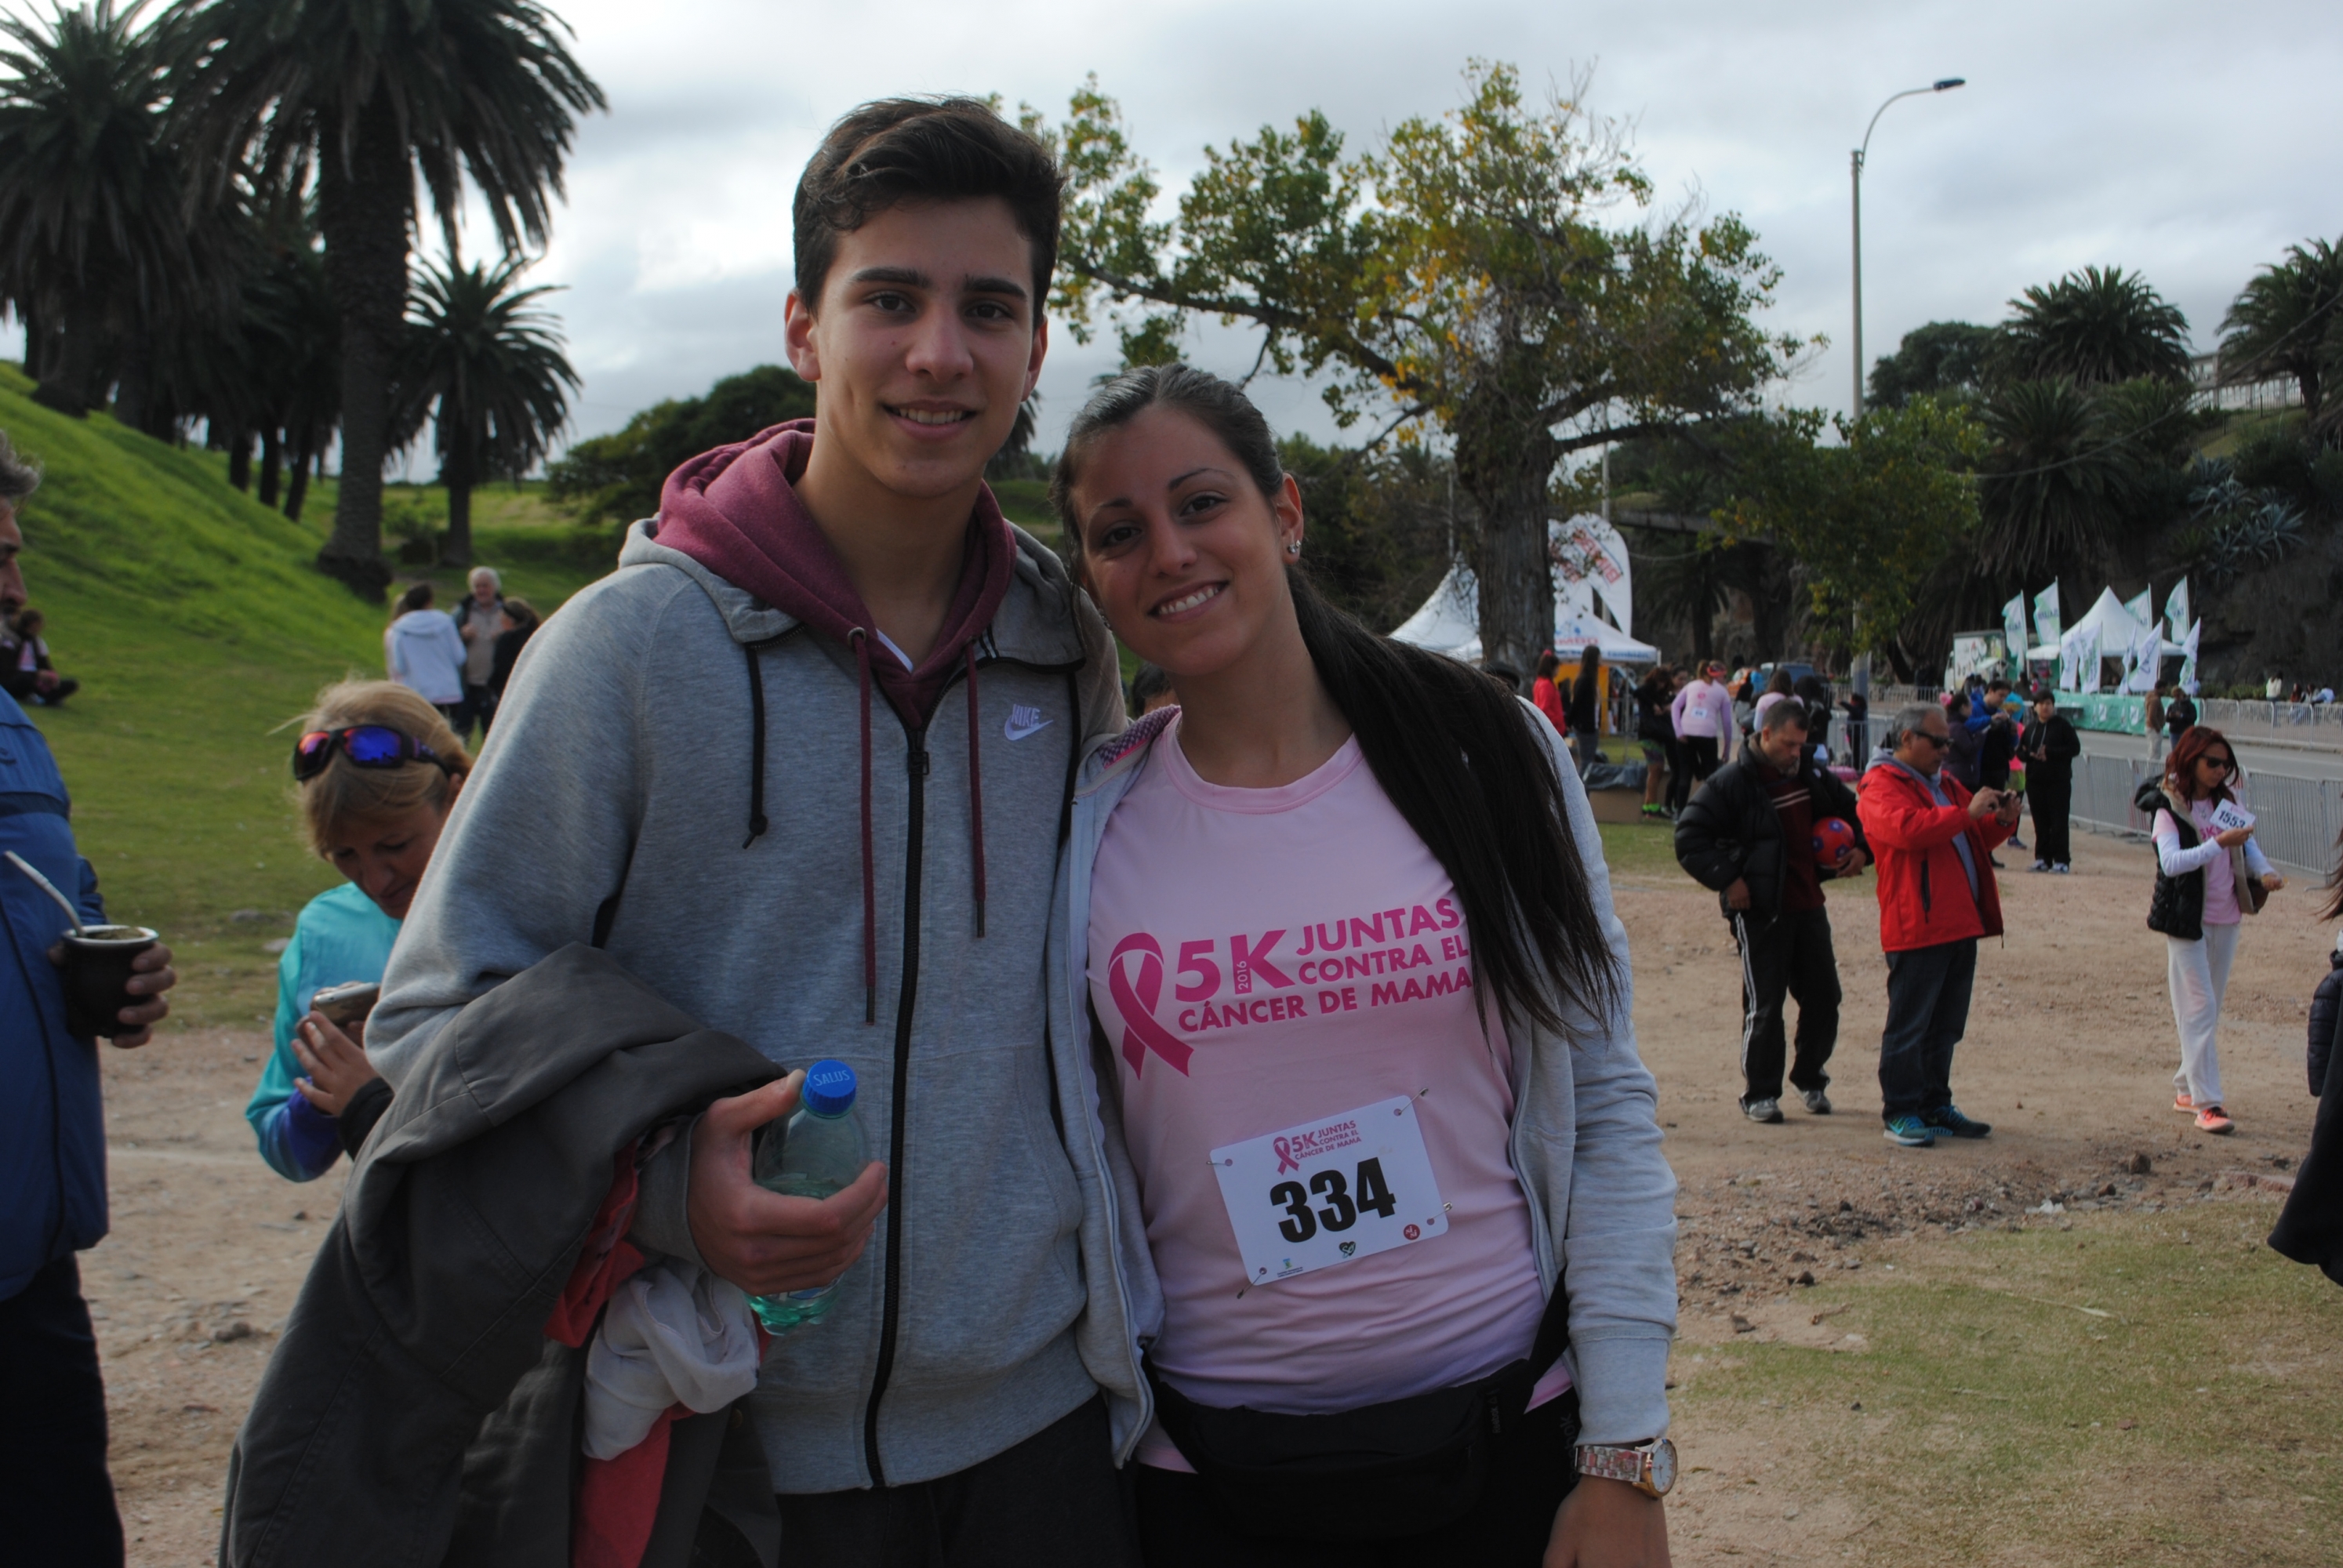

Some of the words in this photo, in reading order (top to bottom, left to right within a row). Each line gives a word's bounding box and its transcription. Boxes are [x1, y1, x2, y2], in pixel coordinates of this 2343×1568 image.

[1011, 703, 1041, 728] NIKE
[1296, 898, 1460, 956] JUNTAS
[1175, 929, 1296, 1003] 5K
[1298, 942, 1433, 985] CONTRA
[1440, 935, 1469, 962] EL
[1237, 960, 1248, 991] 2016
[1178, 995, 1309, 1033] CÁNCER
[1318, 987, 1358, 1014] DE
[1370, 966, 1473, 1007] MAMA
[813, 1069, 850, 1087] SALUS
[1291, 1131, 1320, 1153] 5K
[1317, 1120, 1357, 1138] JUNTAS
[1319, 1132, 1349, 1145] CONTRA
[1326, 1143, 1335, 1152] DE
[1337, 1137, 1362, 1149] MAMA
[1269, 1156, 1397, 1243] 334
